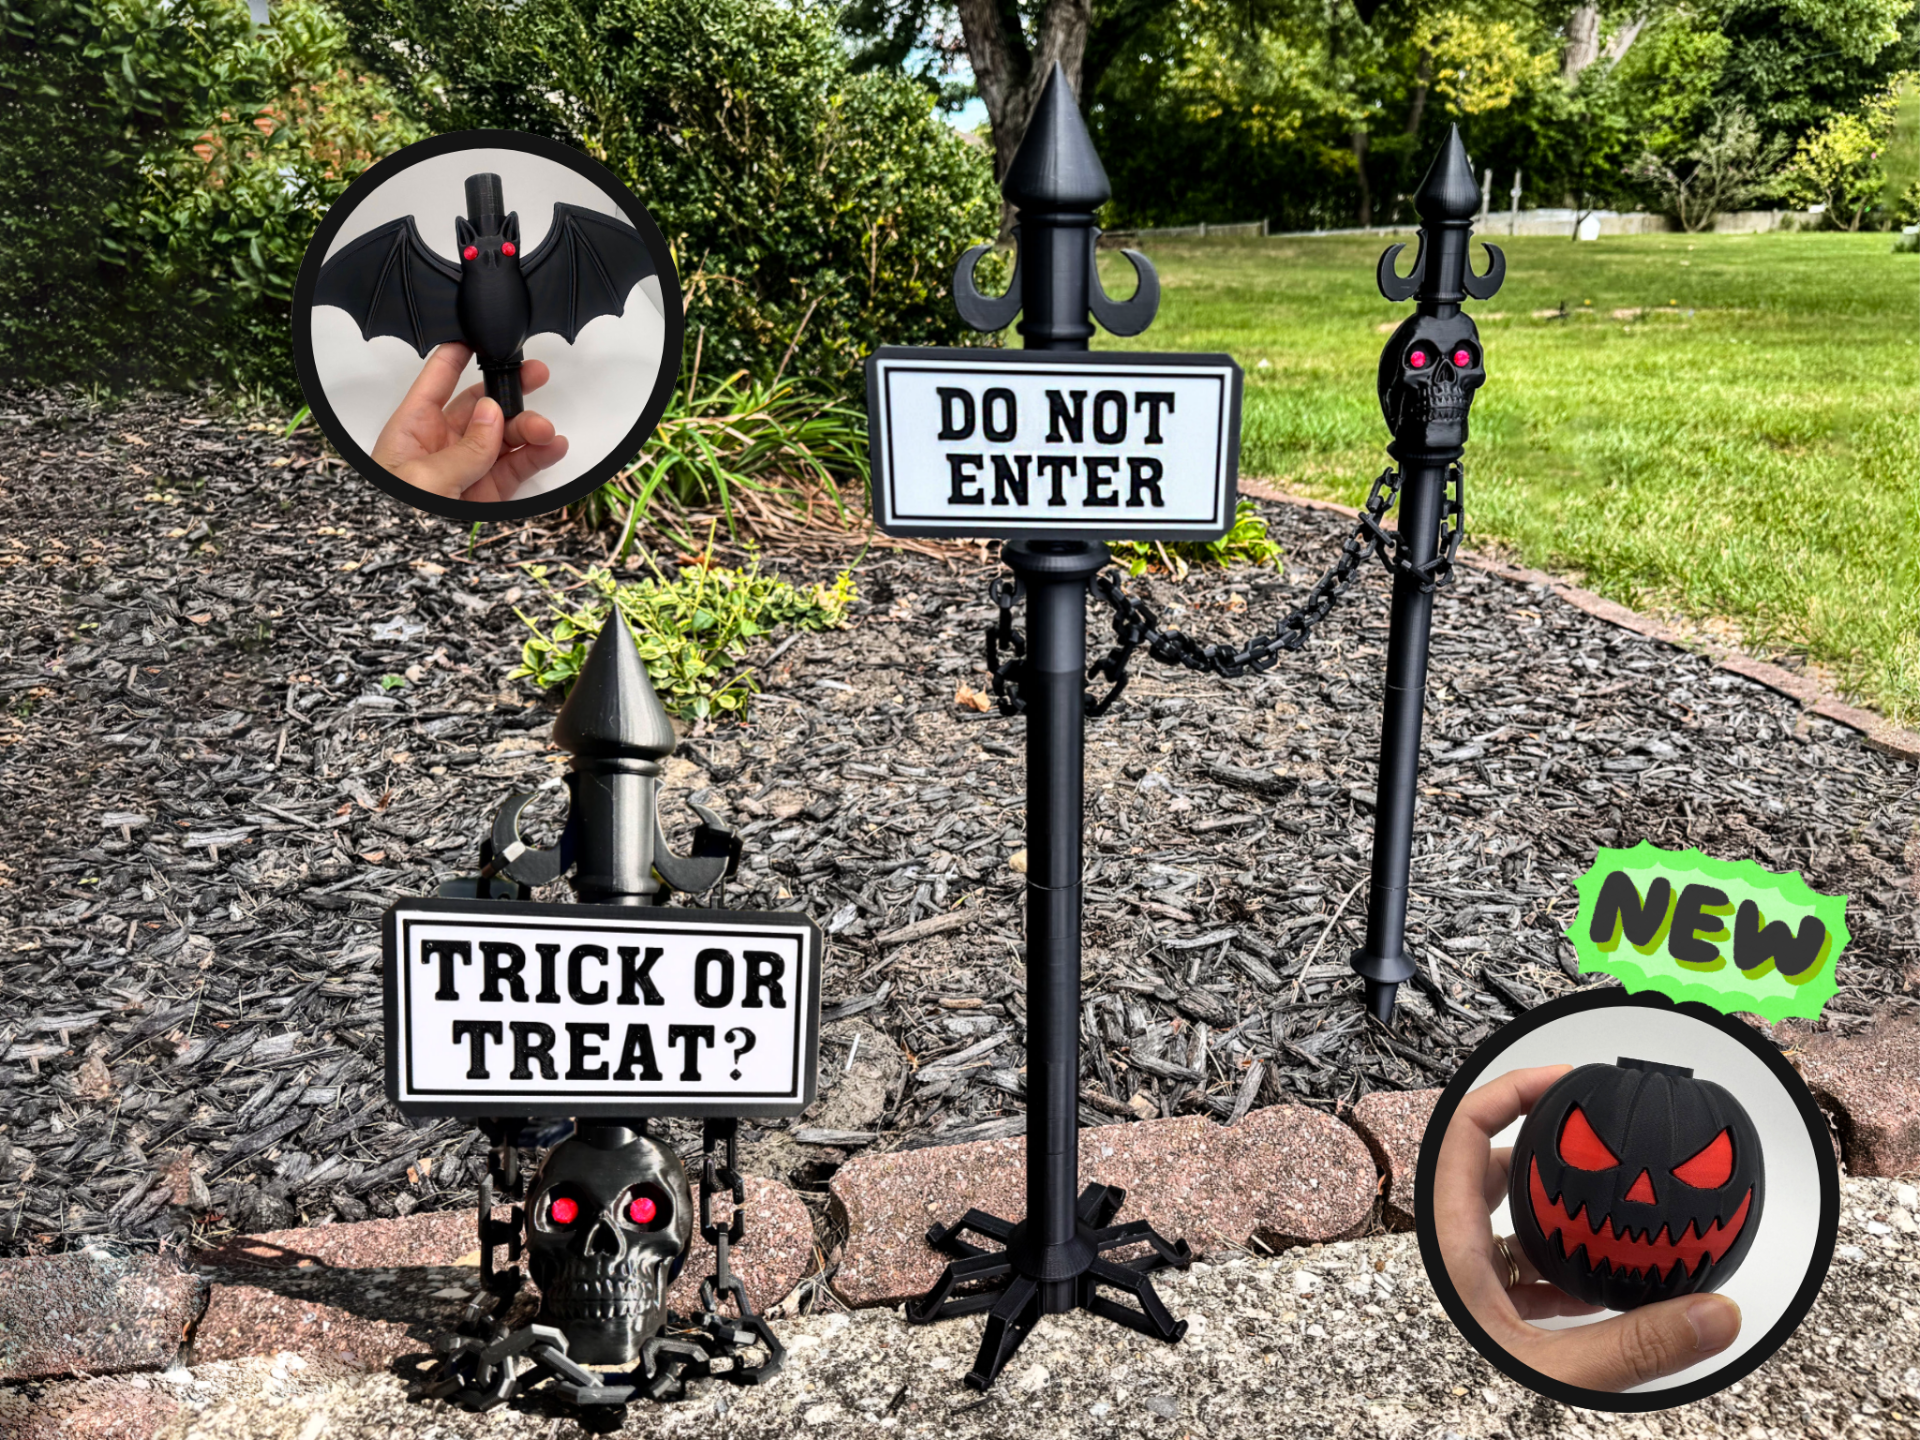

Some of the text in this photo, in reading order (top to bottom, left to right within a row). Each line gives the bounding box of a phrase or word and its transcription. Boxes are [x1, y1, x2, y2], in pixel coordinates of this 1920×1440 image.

[936, 386, 1175, 445] DO NOT
[946, 453, 1165, 508] ENTER
[420, 938, 787, 1009] TRICK OR
[452, 1019, 757, 1082] TREAT?
